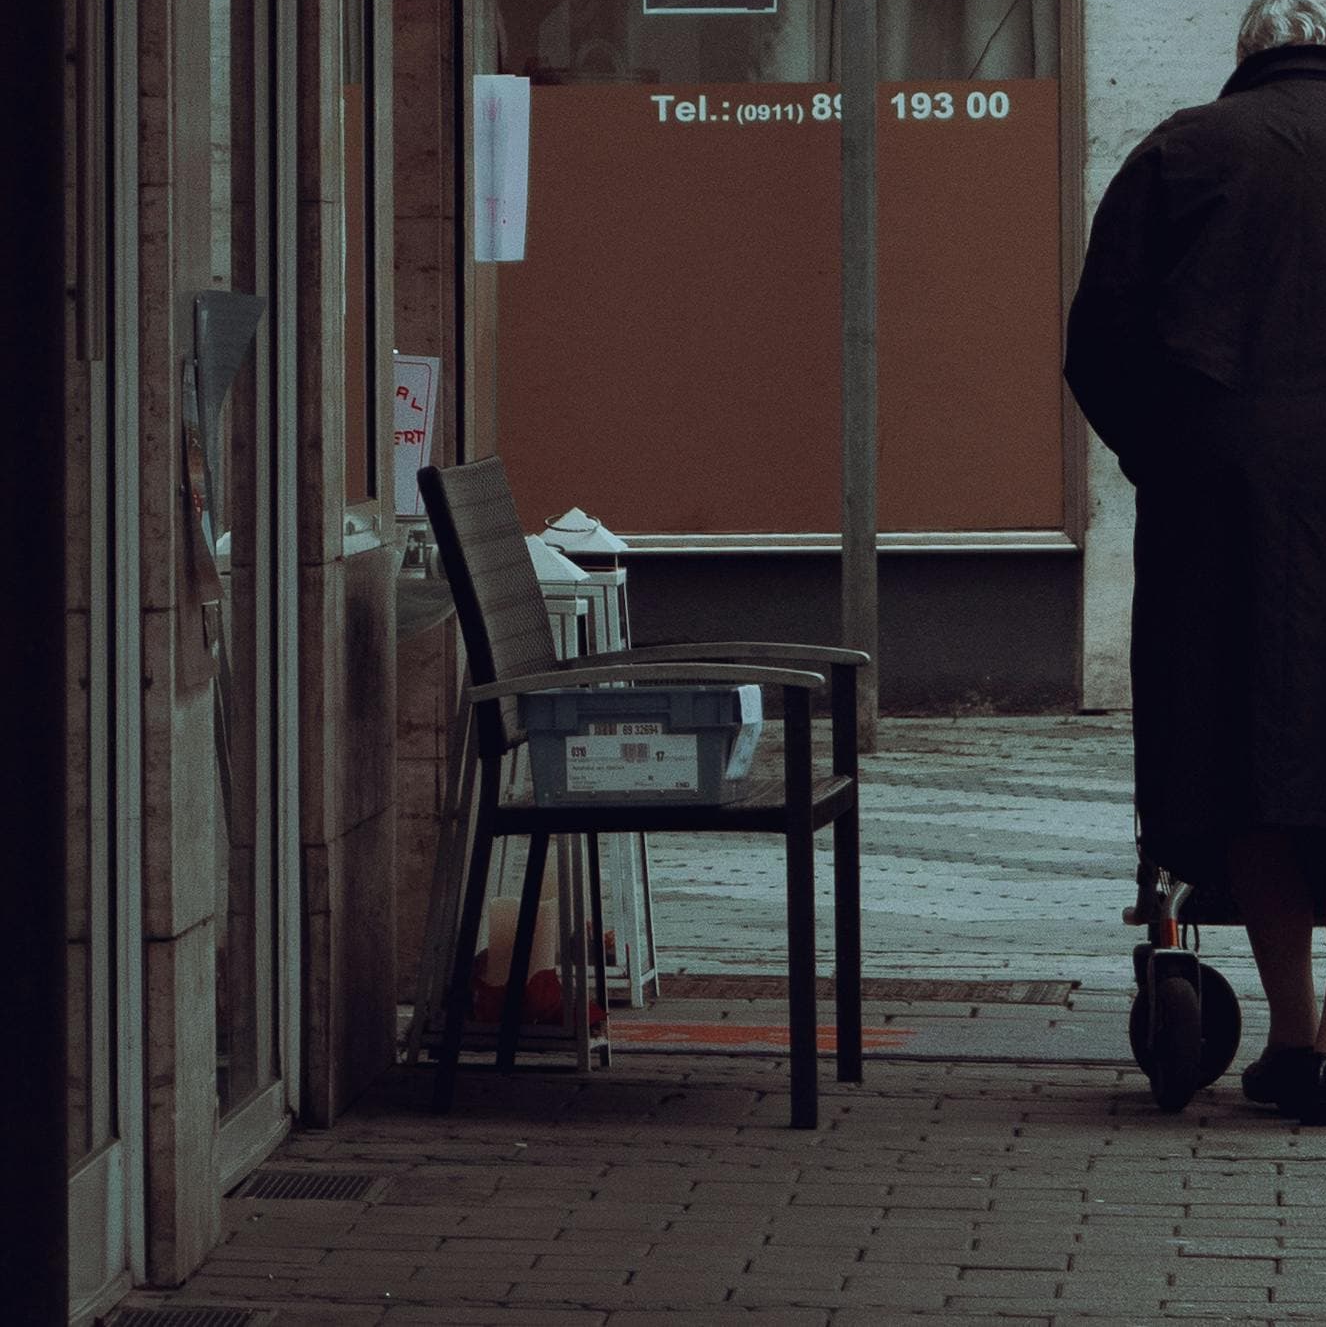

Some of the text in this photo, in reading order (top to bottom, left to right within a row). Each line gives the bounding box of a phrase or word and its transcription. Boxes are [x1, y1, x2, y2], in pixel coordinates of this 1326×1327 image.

[650, 95, 730, 122] Tel.:
[736, 103, 804, 125] (0911)
[890, 91, 954, 120] 193
[966, 91, 1010, 120] 00
